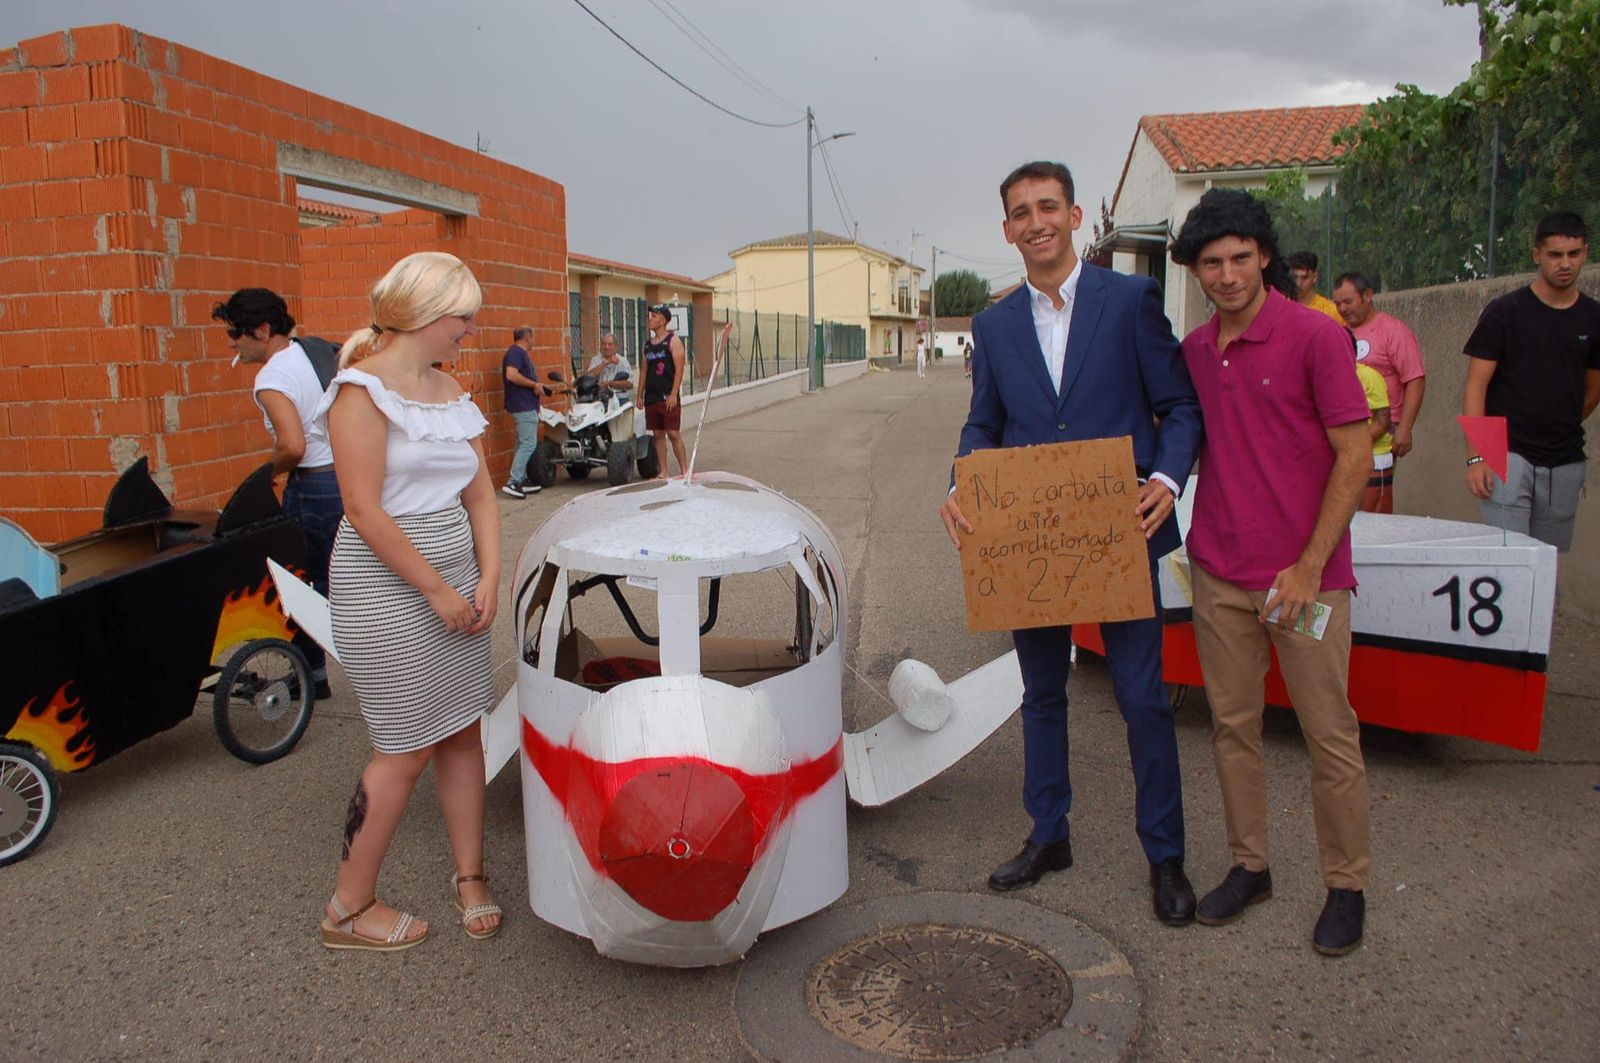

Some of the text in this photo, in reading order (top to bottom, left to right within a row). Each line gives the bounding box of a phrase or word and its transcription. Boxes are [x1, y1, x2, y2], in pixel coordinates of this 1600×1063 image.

[973, 463, 1126, 512] No corbata
[1016, 511, 1061, 532] aire
[978, 523, 1124, 559] acondicionado
[977, 576, 998, 598] a
[1432, 575, 1504, 637] 18
